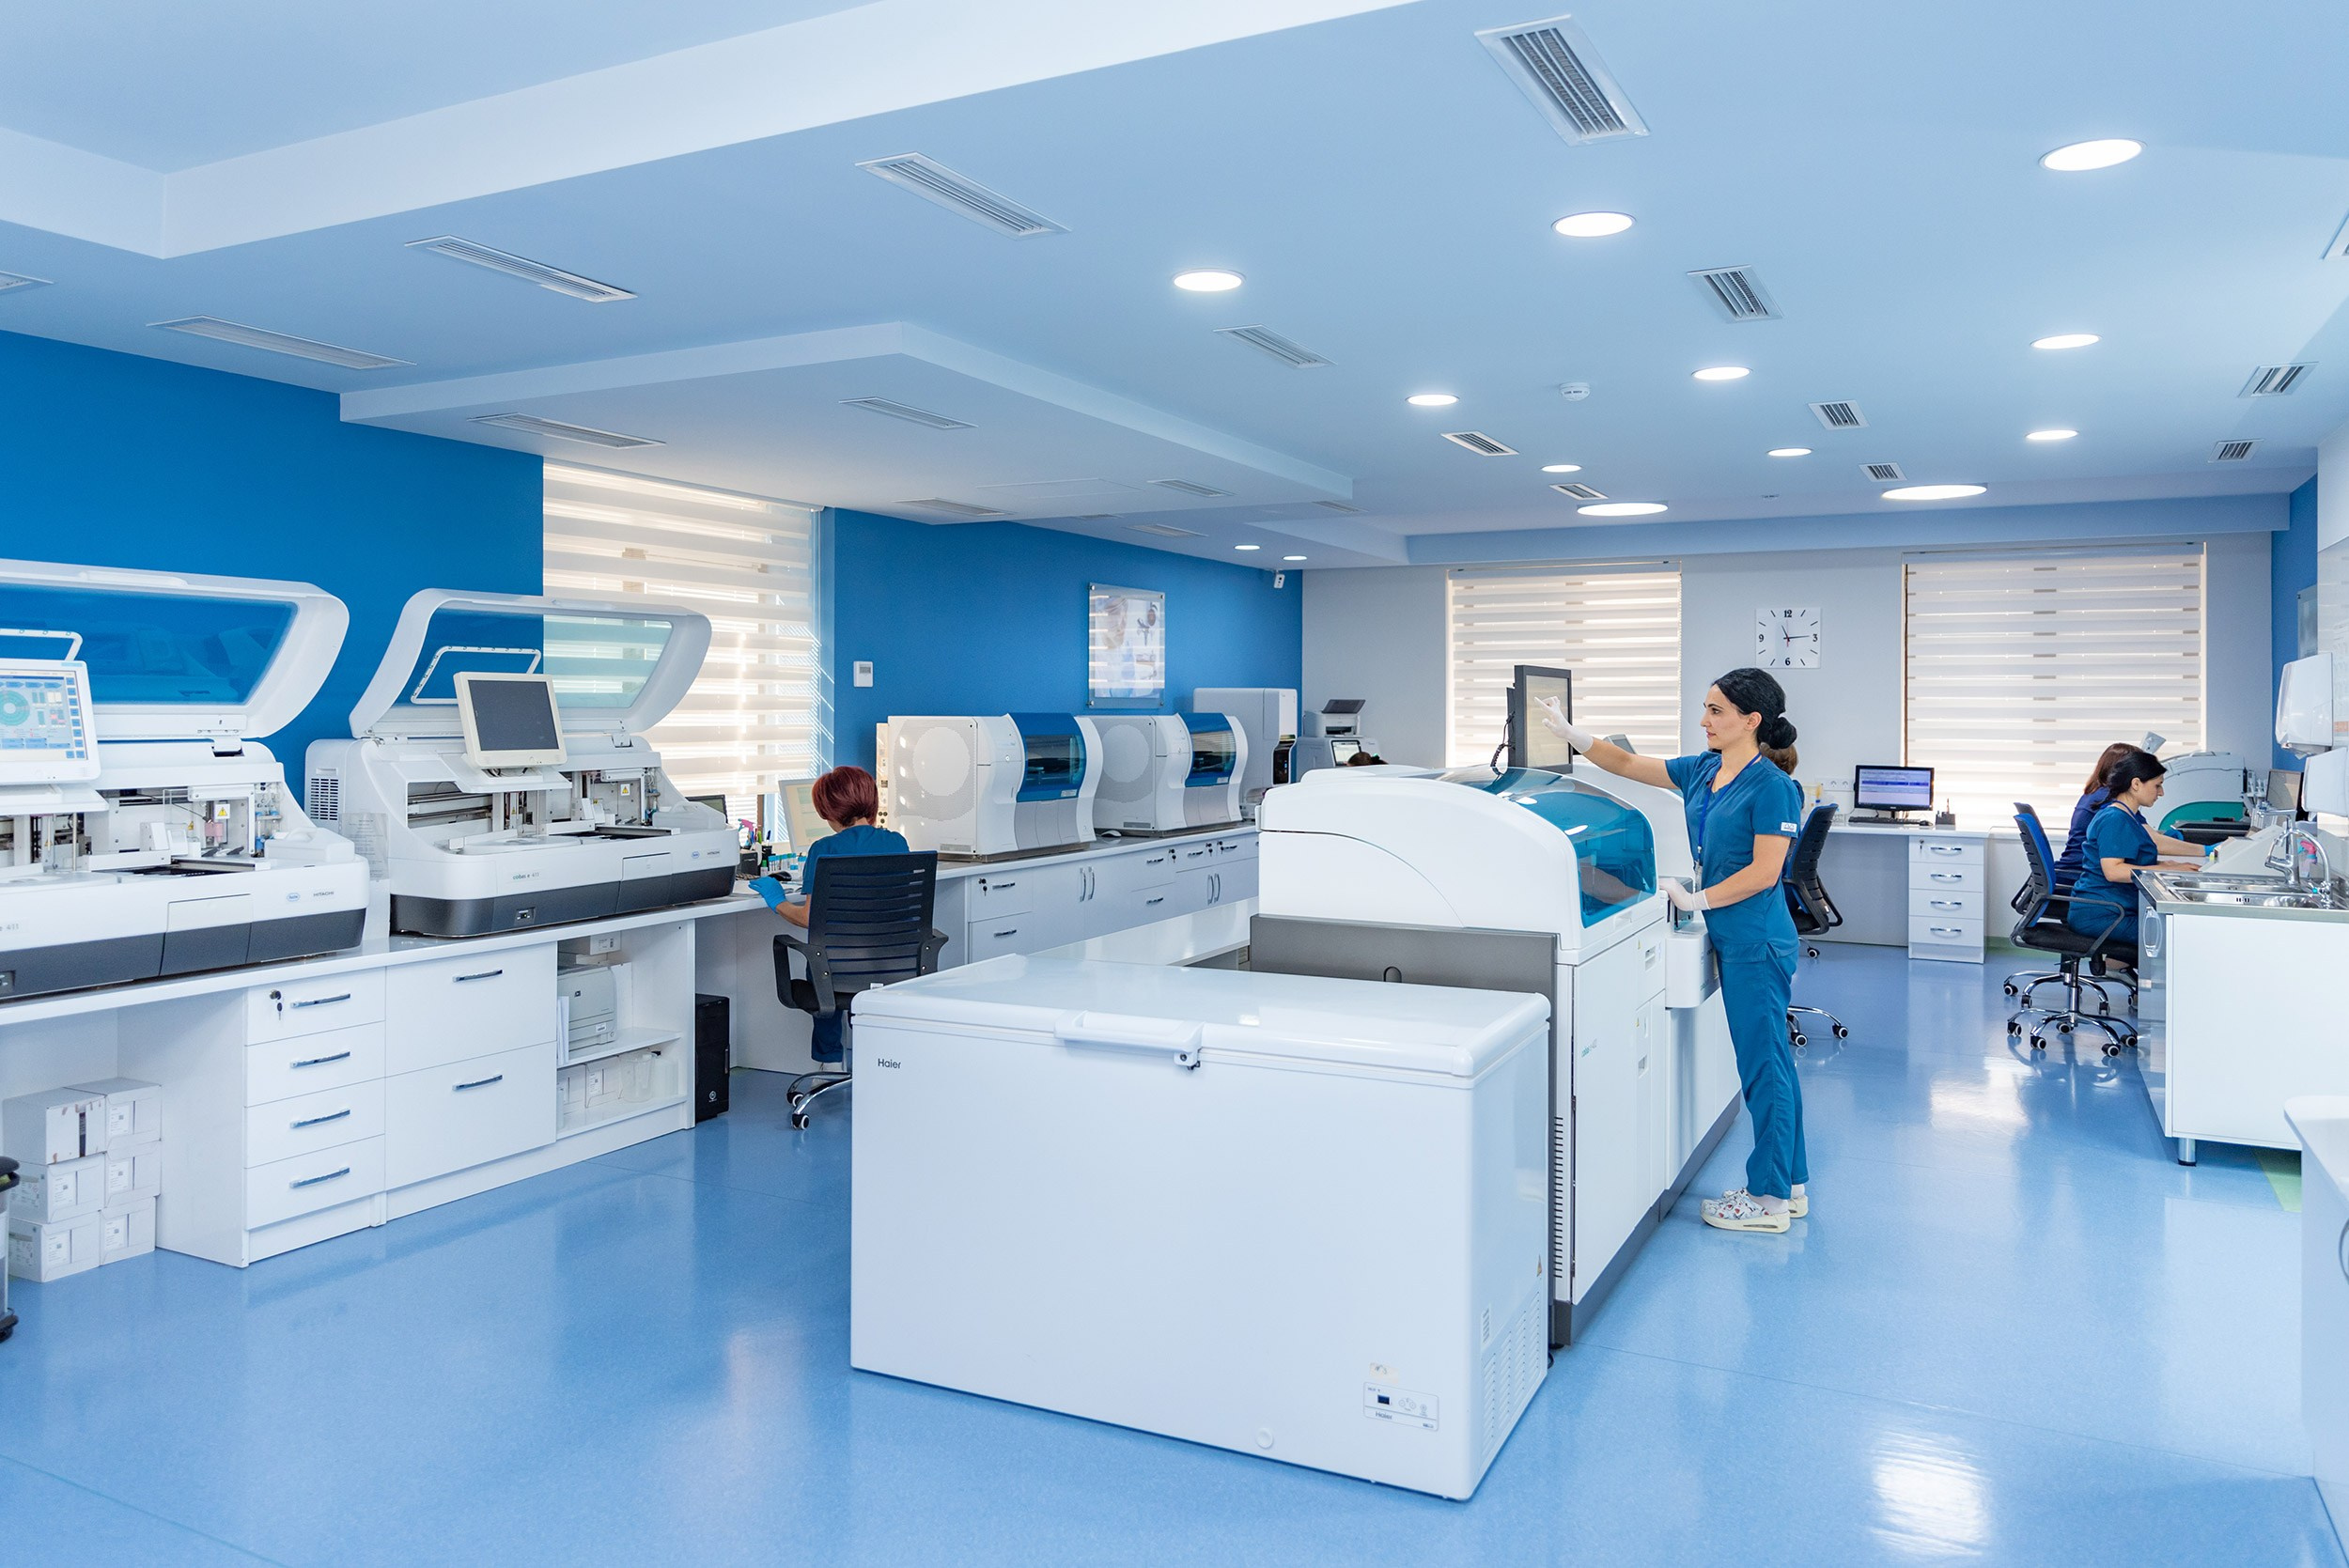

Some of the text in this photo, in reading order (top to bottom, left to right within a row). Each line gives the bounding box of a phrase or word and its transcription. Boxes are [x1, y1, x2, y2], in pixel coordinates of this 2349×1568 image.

[1783, 609, 1793, 618] 12
[1758, 633, 1765, 643] 9
[1812, 633, 1818, 643] 3
[1784, 657, 1791, 666] 6
[878, 1058, 901, 1069] Haier
[1376, 1411, 1392, 1420] Haier
